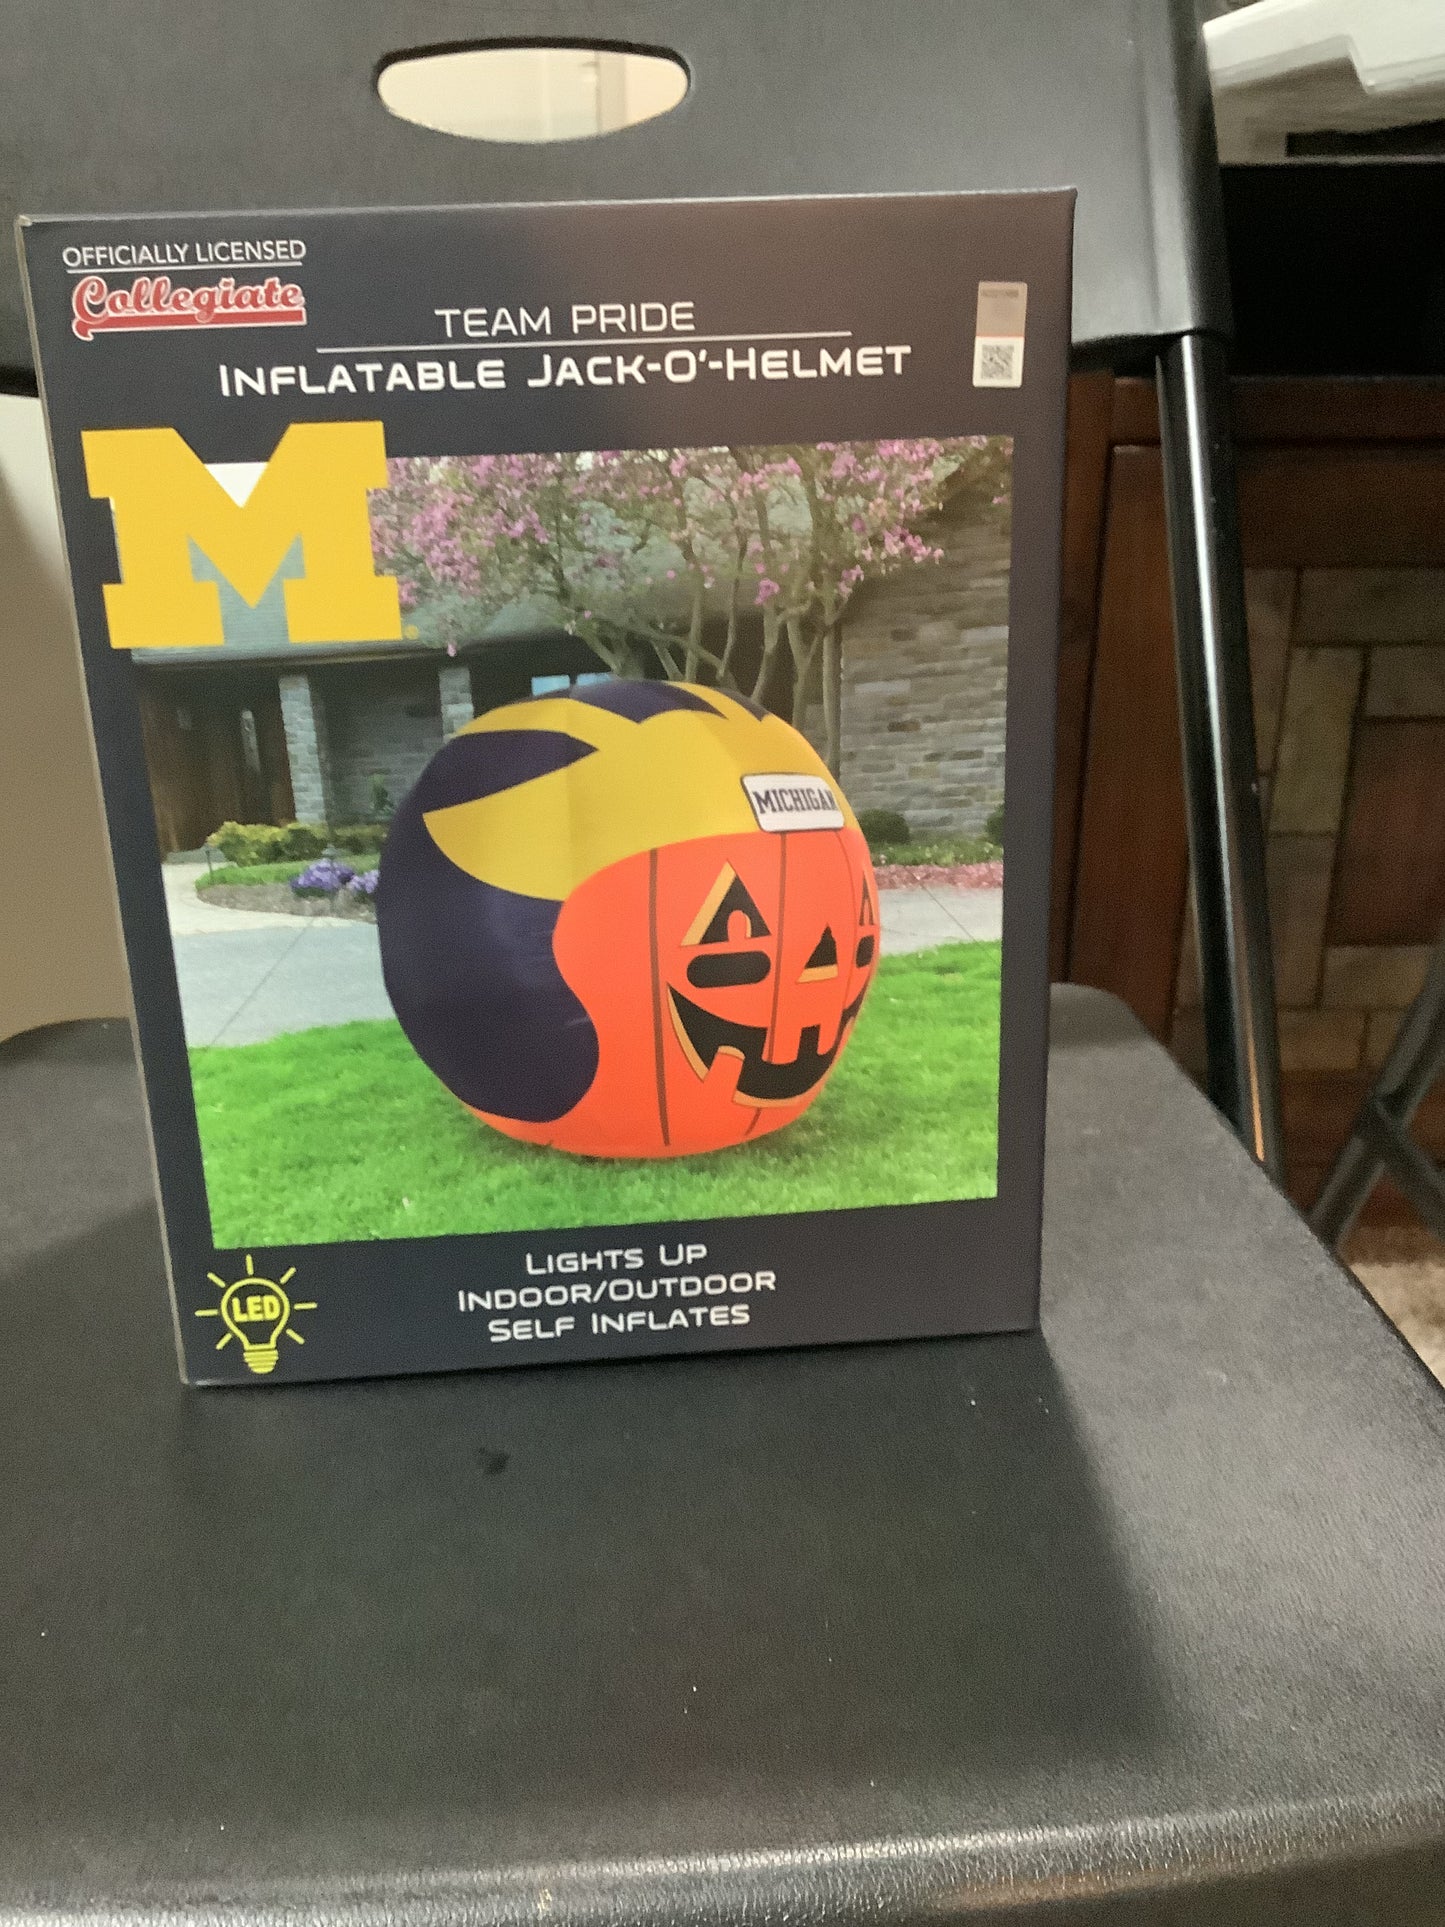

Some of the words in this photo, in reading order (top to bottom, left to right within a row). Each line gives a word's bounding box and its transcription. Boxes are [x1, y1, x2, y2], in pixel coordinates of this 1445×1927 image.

[62, 244, 189, 268] OFFICIALLY
[195, 239, 307, 263] LICENSED
[72, 276, 306, 326] Collegiate
[434, 306, 552, 338] TEAM
[571, 302, 696, 333] PRIDE
[219, 358, 507, 397] INFLATABLE
[81, 421, 402, 649] M
[752, 787, 838, 815] MICHIGAN
[525, 1248, 645, 1276] LIGHTS
[659, 1243, 708, 1268] UP
[231, 1295, 281, 1322] LED
[458, 1271, 778, 1313] INDOOR/OUTDOOR
[487, 1317, 575, 1343] SELF
[591, 1304, 751, 1336] INFLATES
